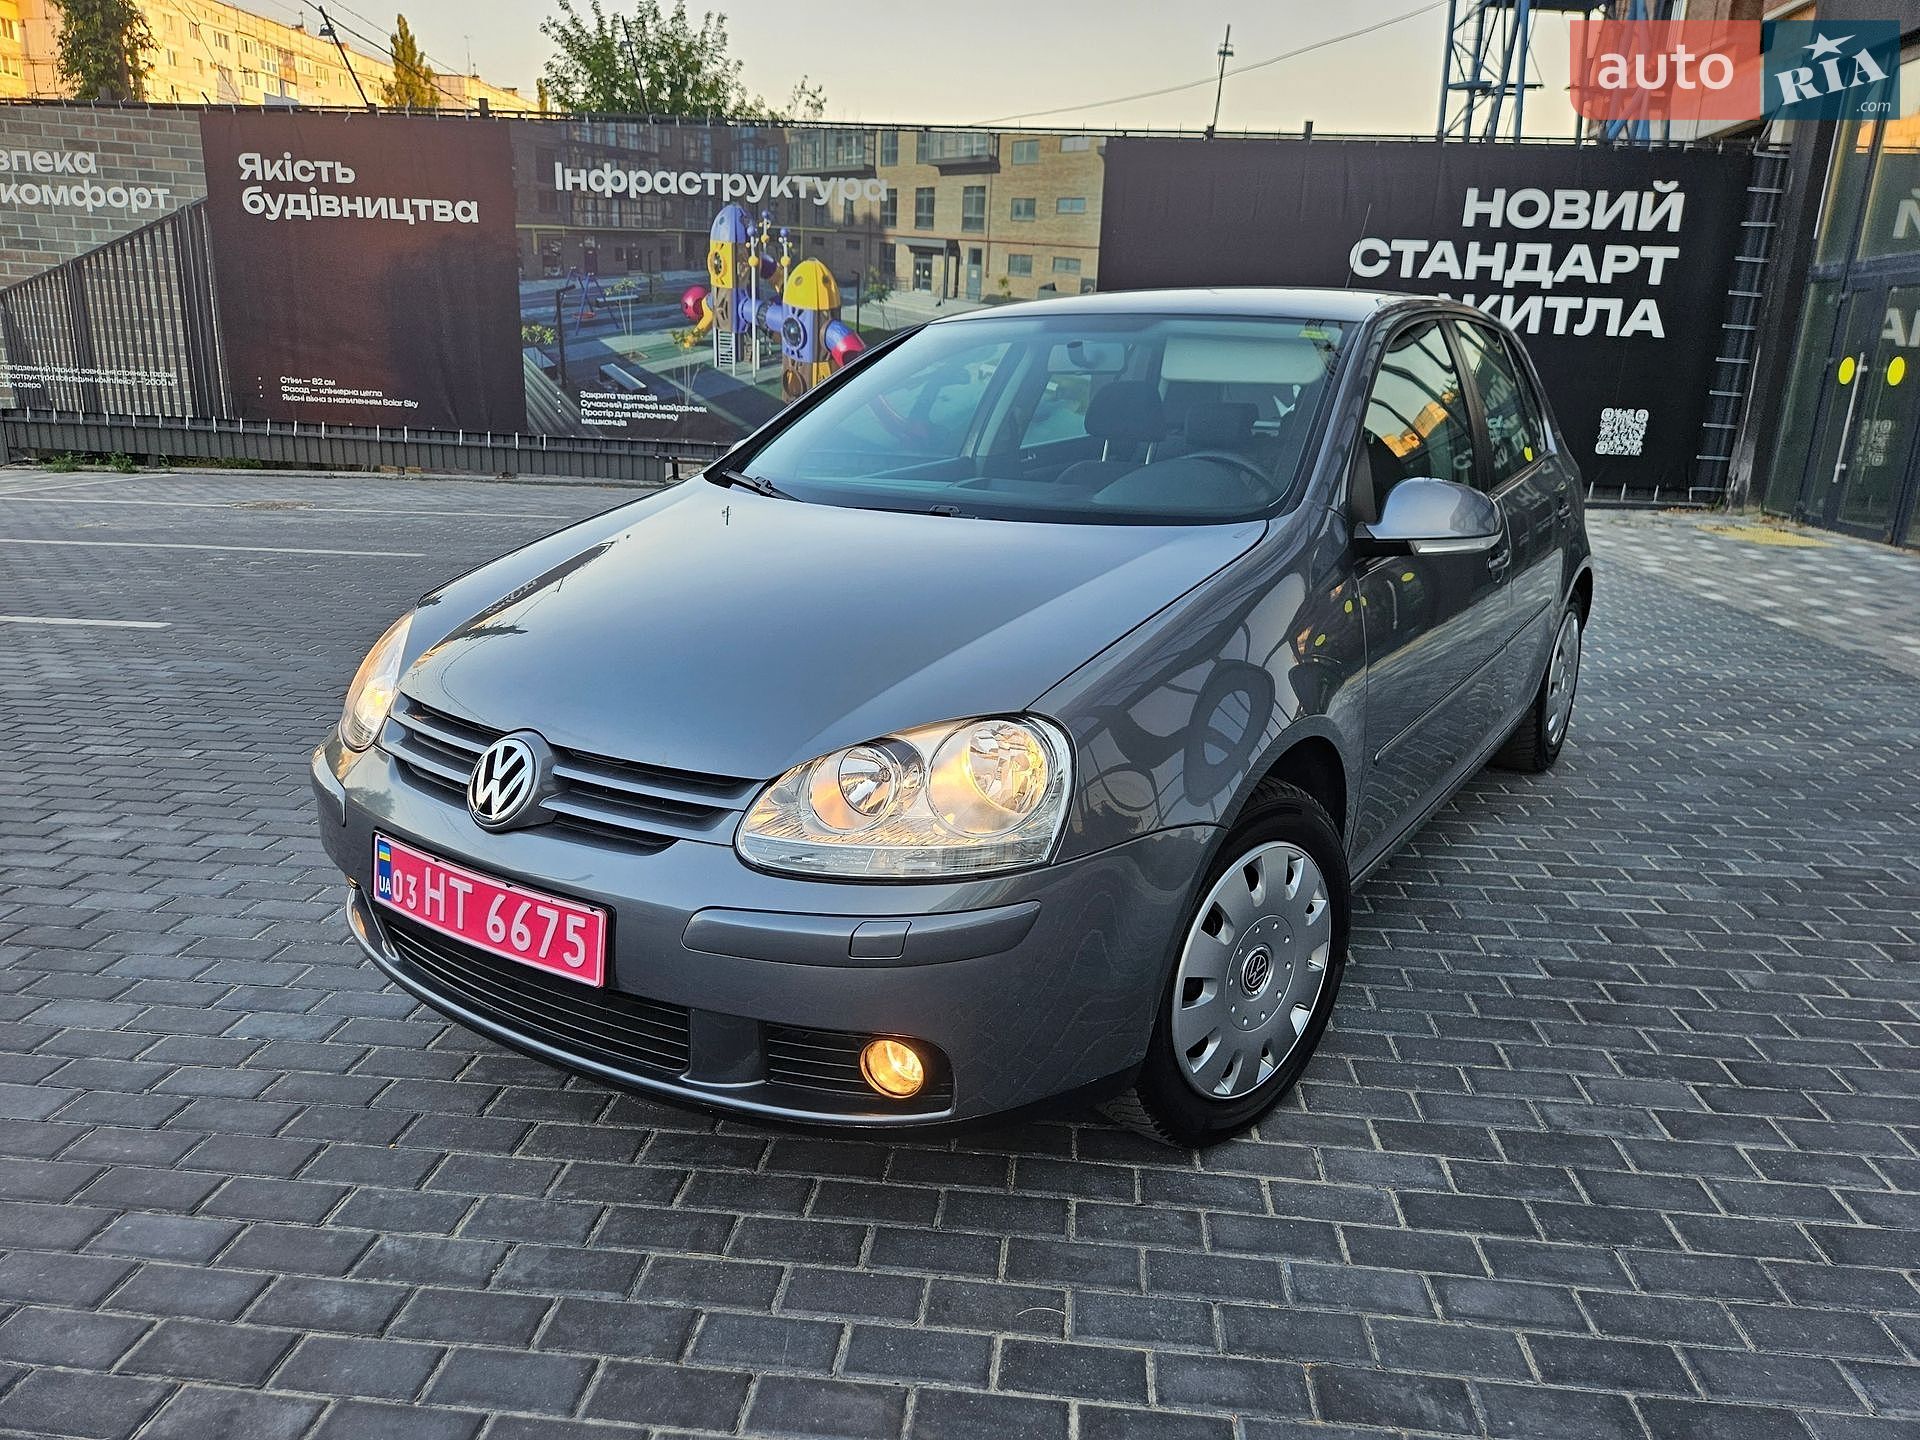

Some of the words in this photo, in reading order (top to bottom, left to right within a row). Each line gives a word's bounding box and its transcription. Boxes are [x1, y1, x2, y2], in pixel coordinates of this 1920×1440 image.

[238, 152, 356, 185] Якість
[554, 161, 888, 206] Інфраструктура
[0, 179, 170, 213] комфорт
[242, 185, 479, 225] будівництва
[1462, 180, 1685, 233] НОВИЙ
[1349, 238, 1680, 289] СТАНДАРТ
[1438, 292, 1665, 338] ИТЛА
[18, 382, 41, 390] озеро
[145, 379, 167, 387] 2000
[280, 376, 302, 385] Стіни
[312, 377, 323, 386] 82
[281, 385, 310, 395] Фасад
[580, 391, 616, 400] Закрита
[616, 393, 658, 402] територія
[282, 394, 305, 402] Якісні
[306, 395, 327, 403] вікна
[333, 396, 382, 405] напиленням
[382, 399, 403, 407] Solar
[403, 399, 419, 409] Sky
[580, 399, 622, 409] Сучасний
[622, 401, 658, 411] дитячий
[659, 403, 707, 413] майданчик
[581, 408, 614, 418] Простір
[614, 410, 631, 418] для
[581, 418, 627, 427] мешканців
[379, 875, 391, 895] UA
[486, 894, 586, 968] 6675
